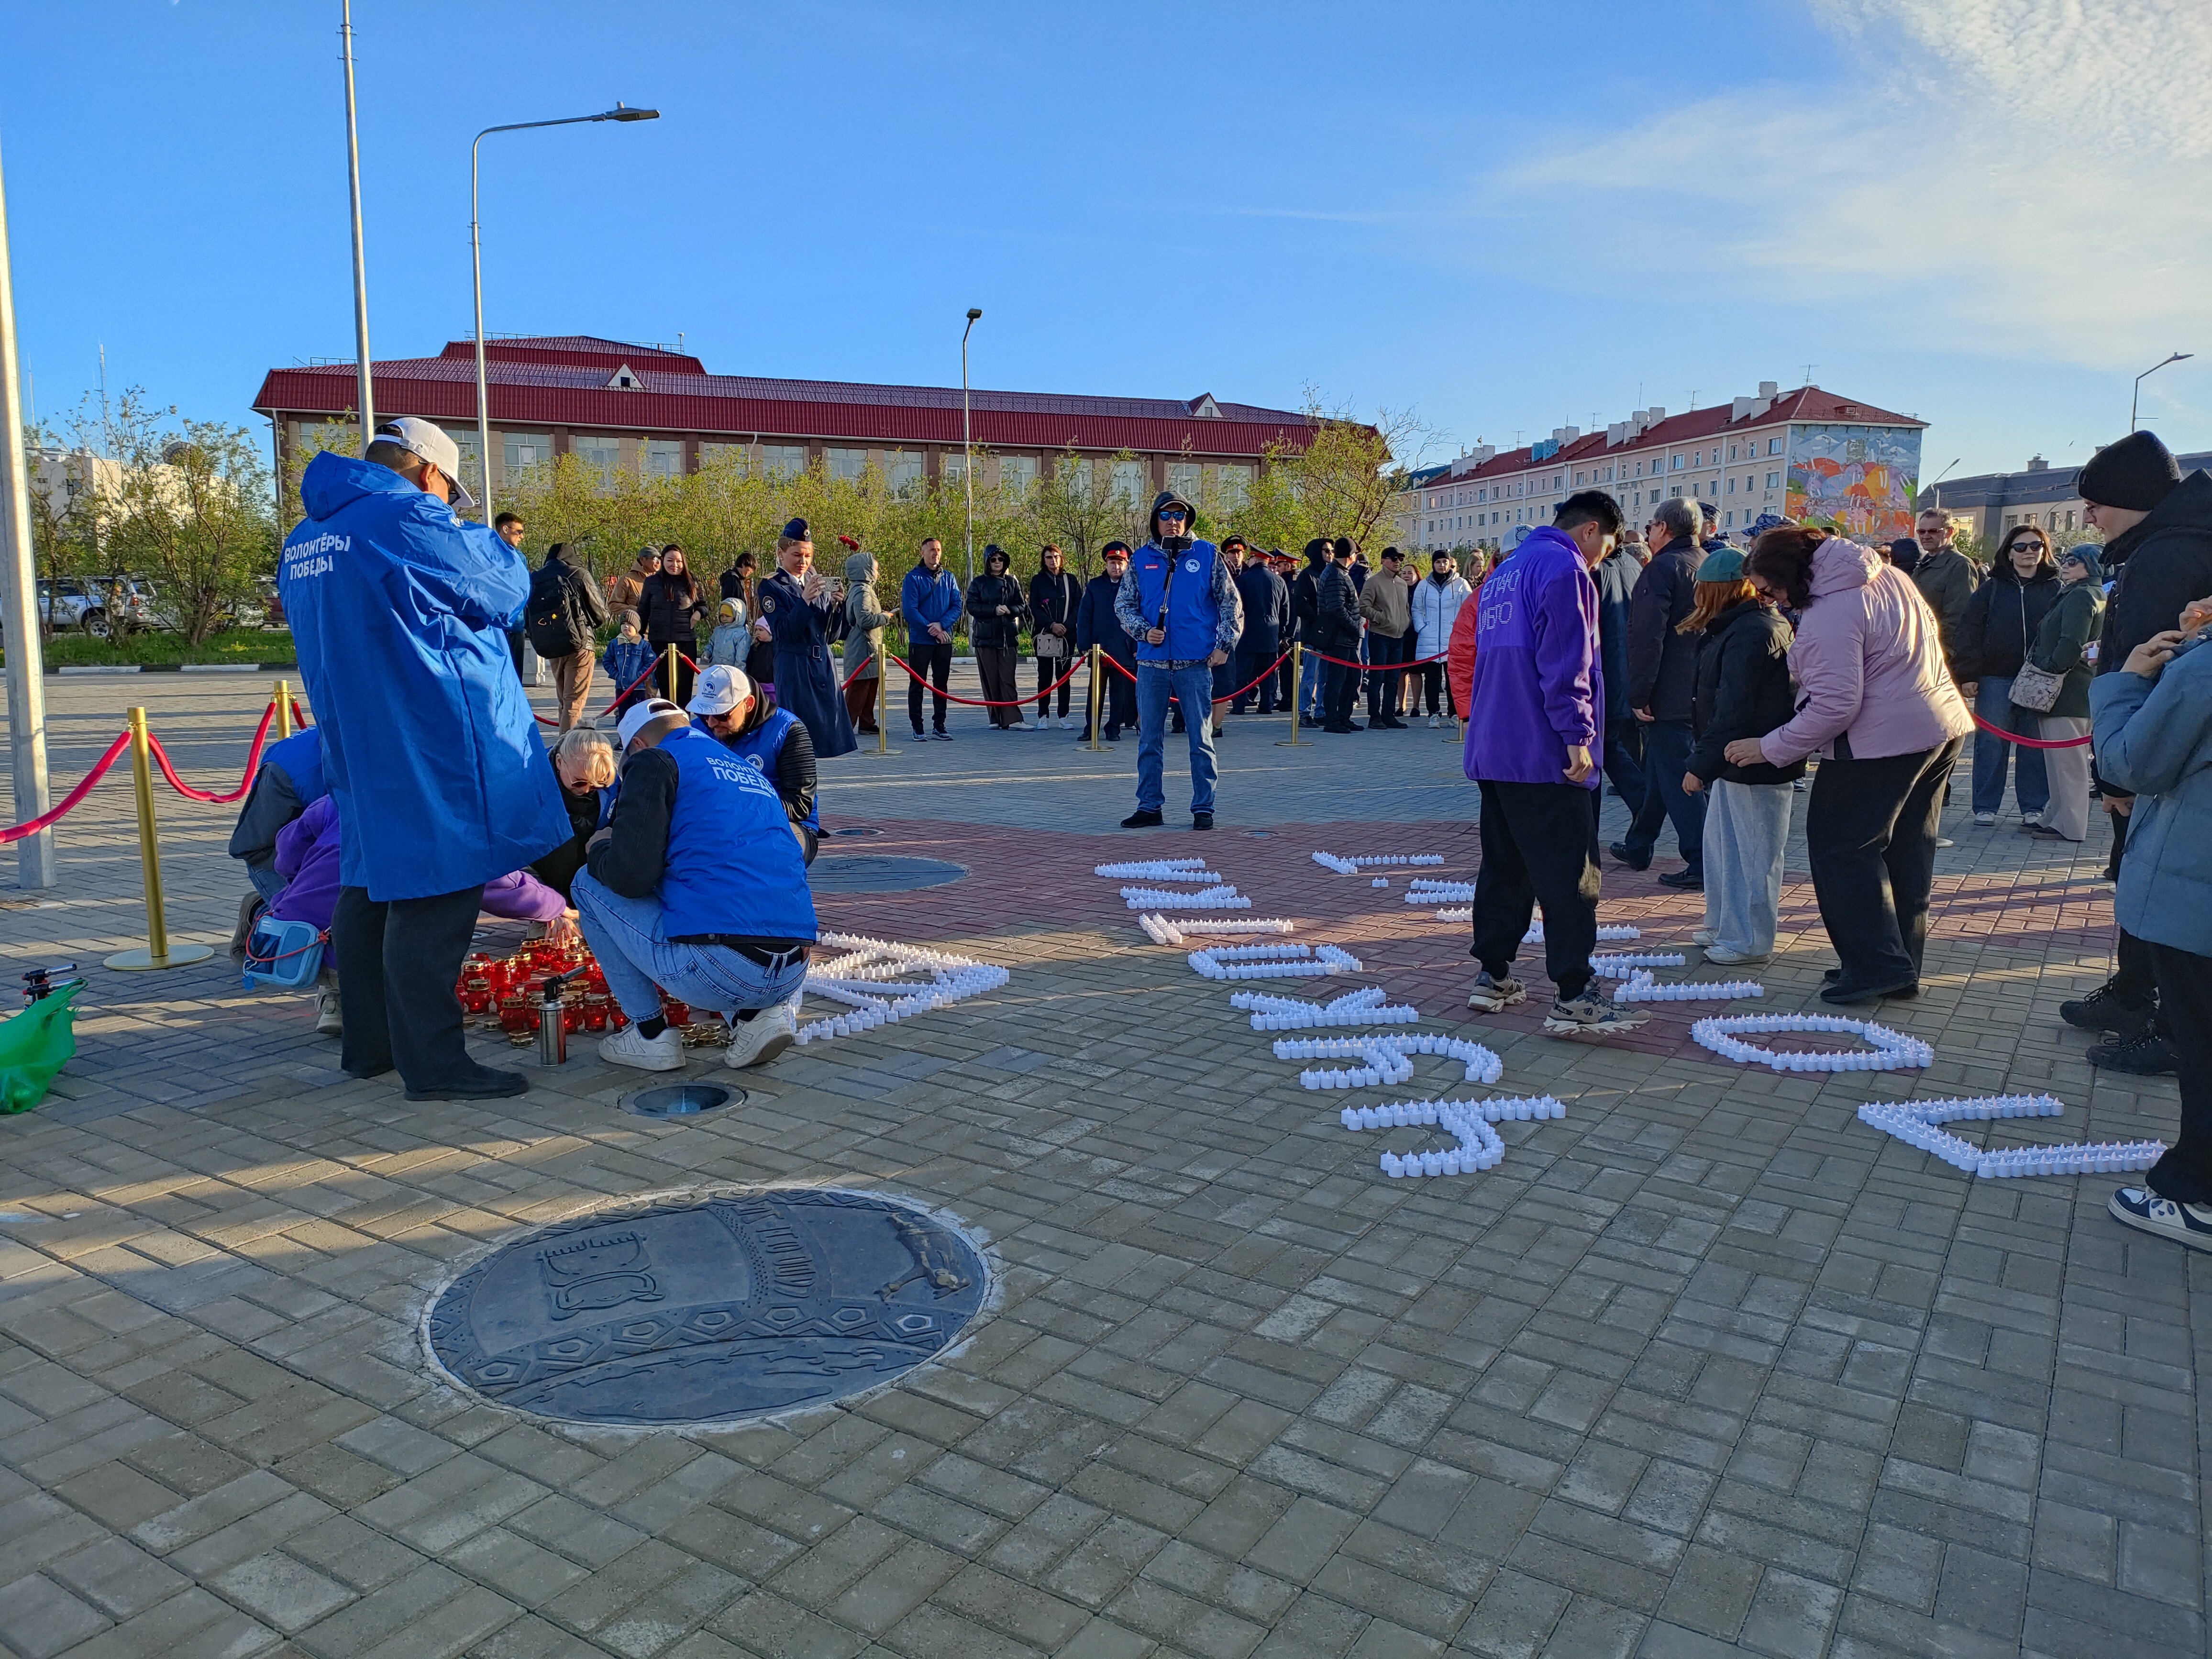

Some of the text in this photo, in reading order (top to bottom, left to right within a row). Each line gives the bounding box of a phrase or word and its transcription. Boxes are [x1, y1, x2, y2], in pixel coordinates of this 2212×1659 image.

[284, 532, 351, 564] ВОЛОНТЁРЫ
[290, 555, 333, 580] ПОБЕДЫ
[712, 766, 779, 800] ПОБЕДЫ
